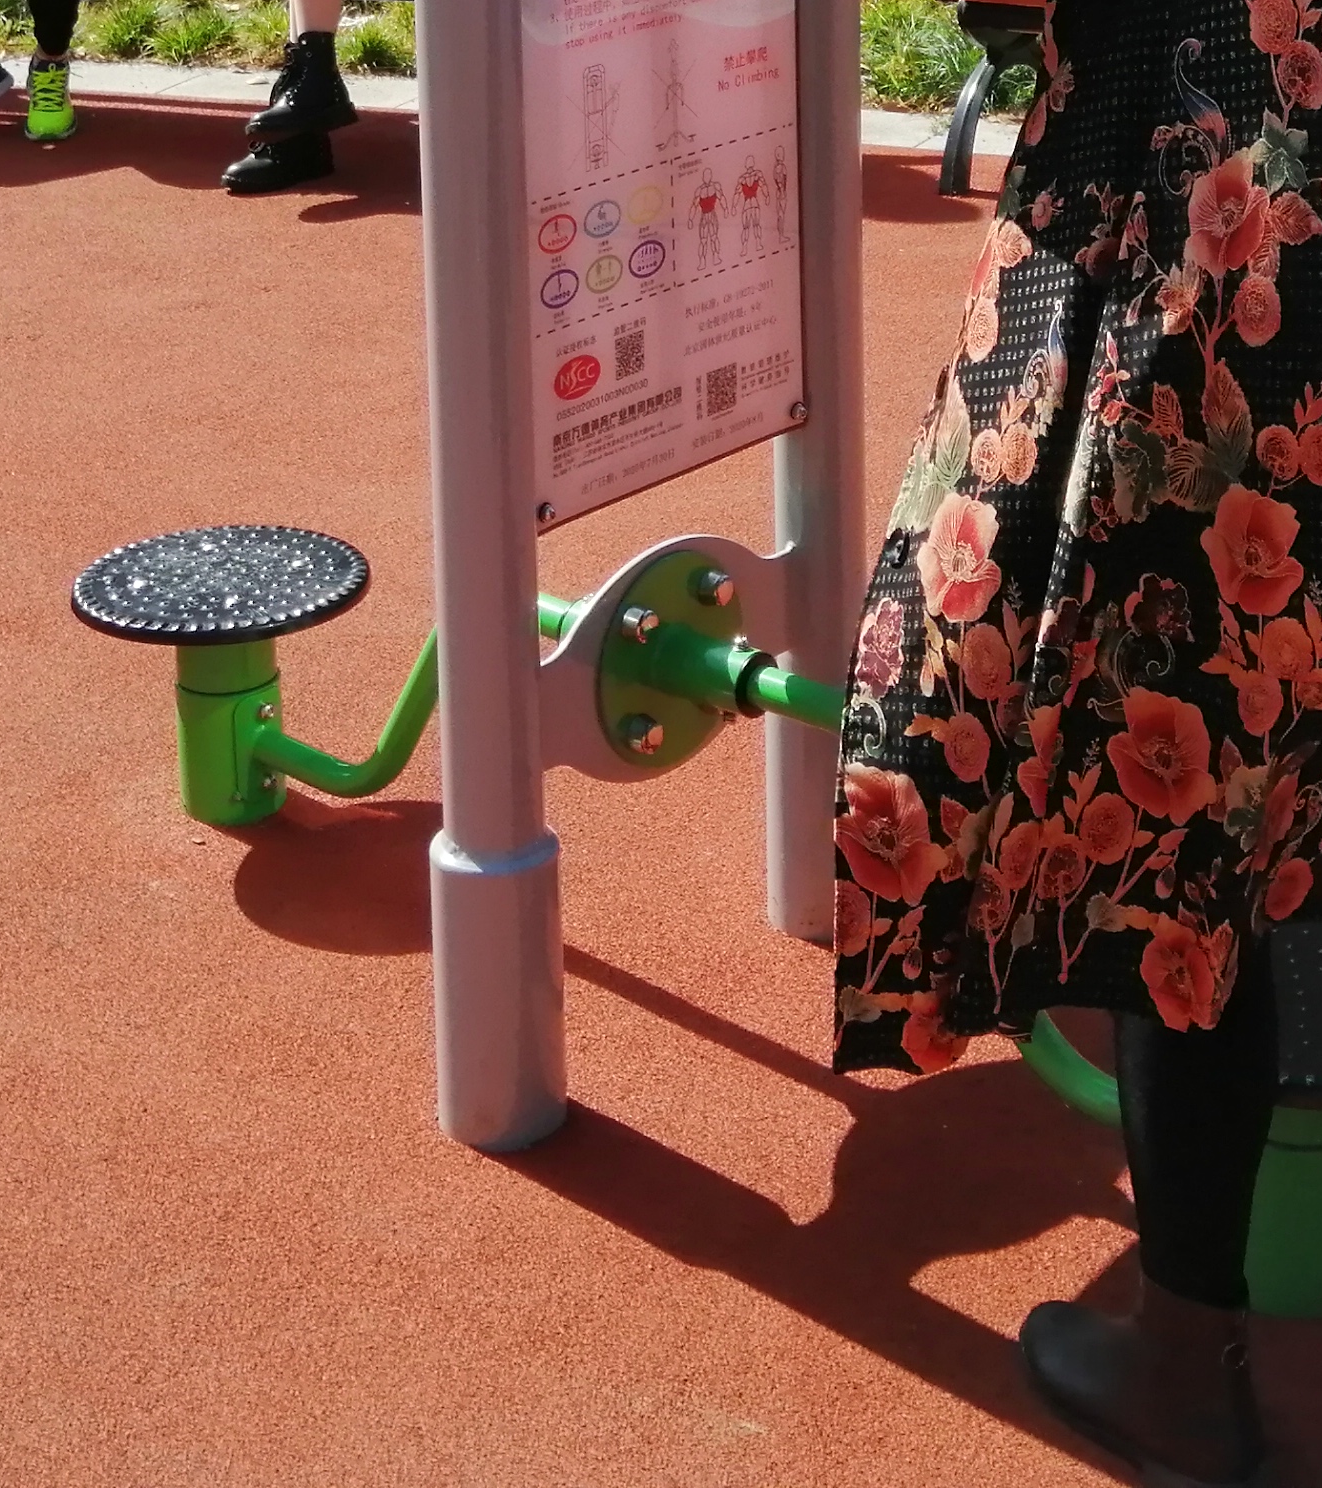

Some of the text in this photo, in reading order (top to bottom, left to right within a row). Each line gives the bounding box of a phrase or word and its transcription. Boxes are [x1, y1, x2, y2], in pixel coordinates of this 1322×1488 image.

[565, 37, 584, 50] stop
[588, 29, 613, 44] using
[617, 26, 627, 35] it
[723, 45, 768, 71] 禁止攀爬
[717, 67, 780, 92] No Climbing
